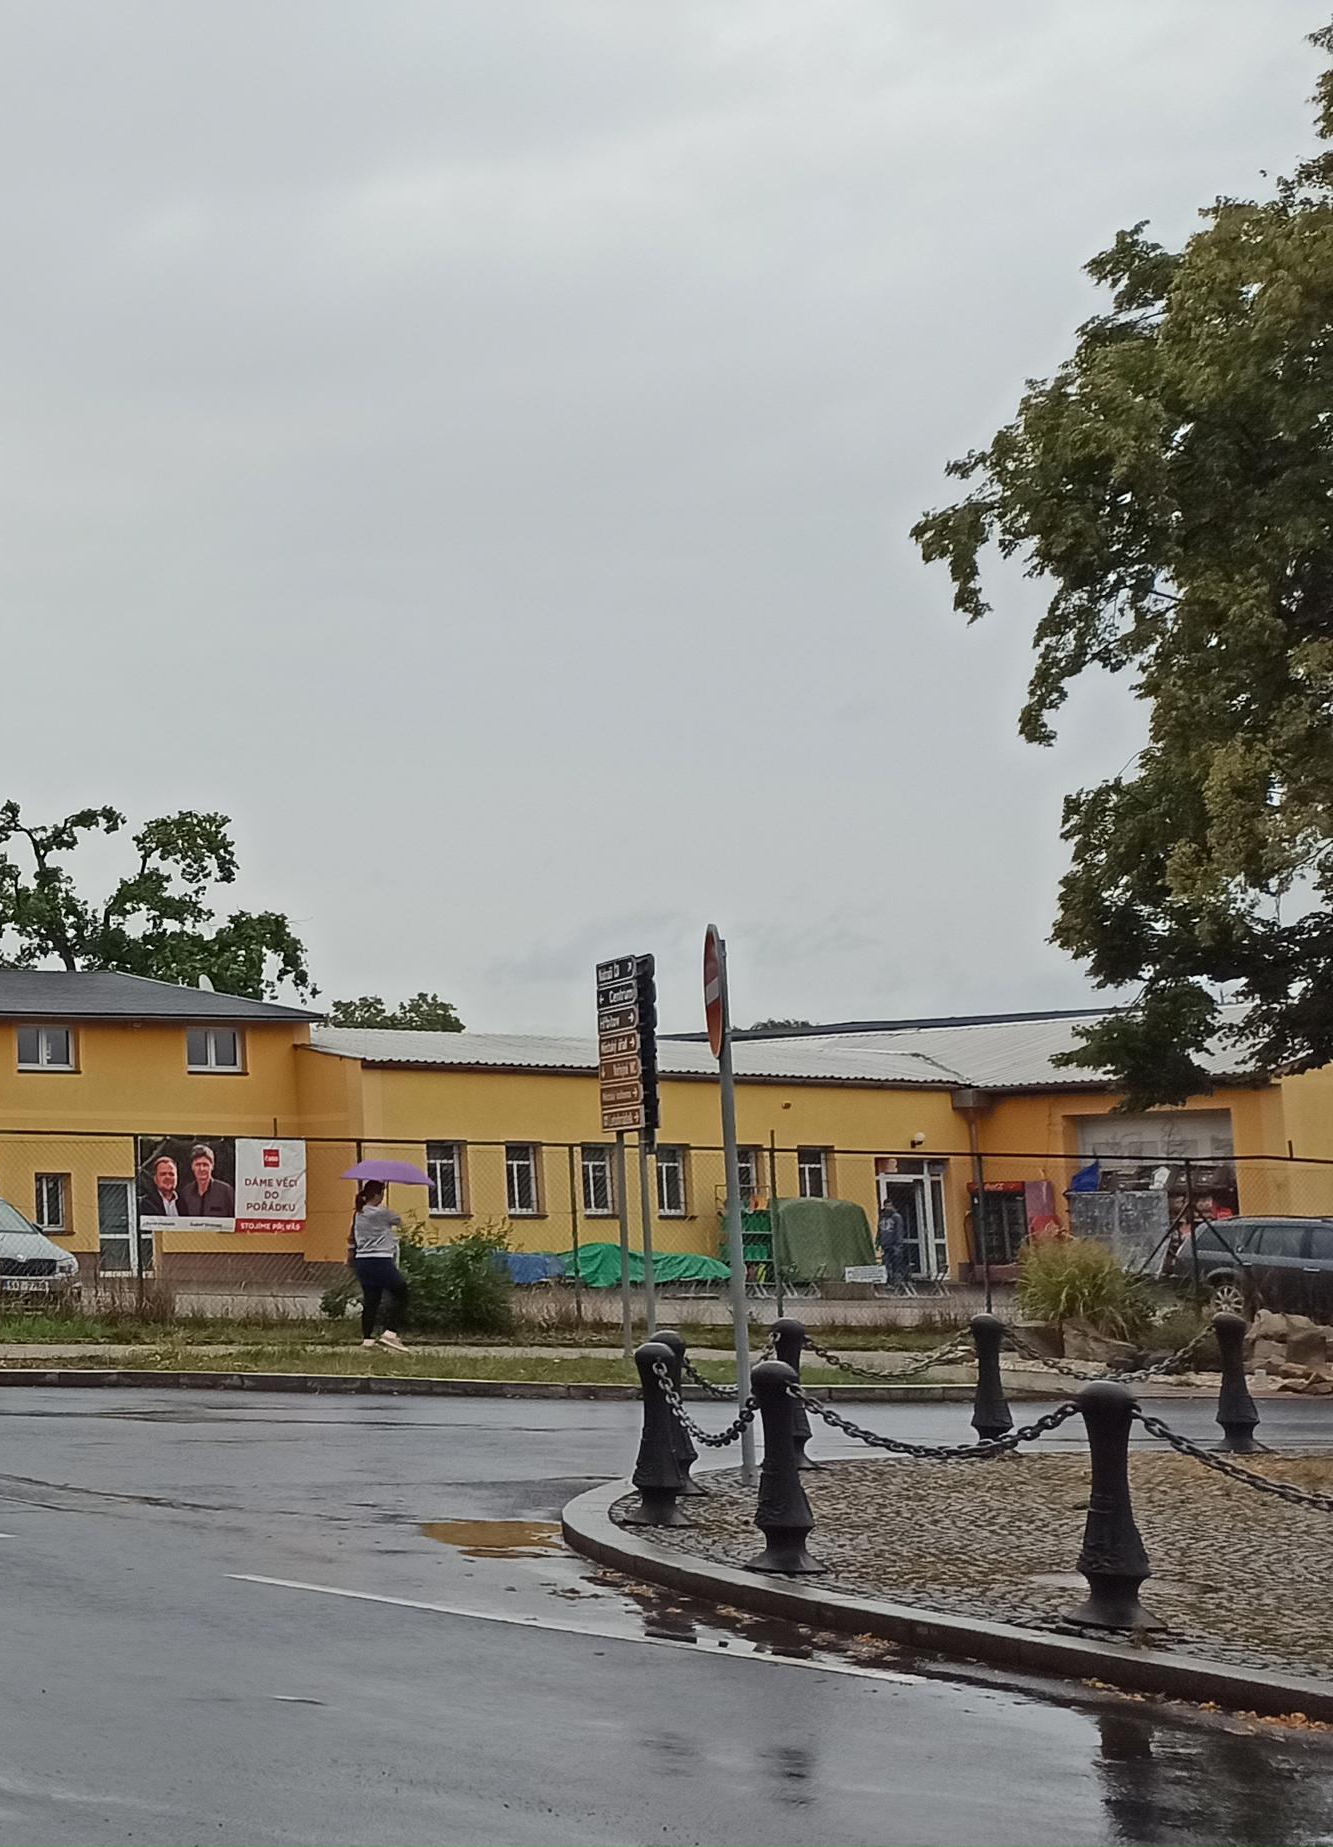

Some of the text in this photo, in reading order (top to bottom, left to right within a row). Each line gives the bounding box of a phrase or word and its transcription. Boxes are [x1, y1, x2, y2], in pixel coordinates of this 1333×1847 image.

[244, 1176, 298, 1188] DÁME VĚCI
[264, 1190, 279, 1200] DO
[245, 1200, 296, 1212] POŘÁDKU
